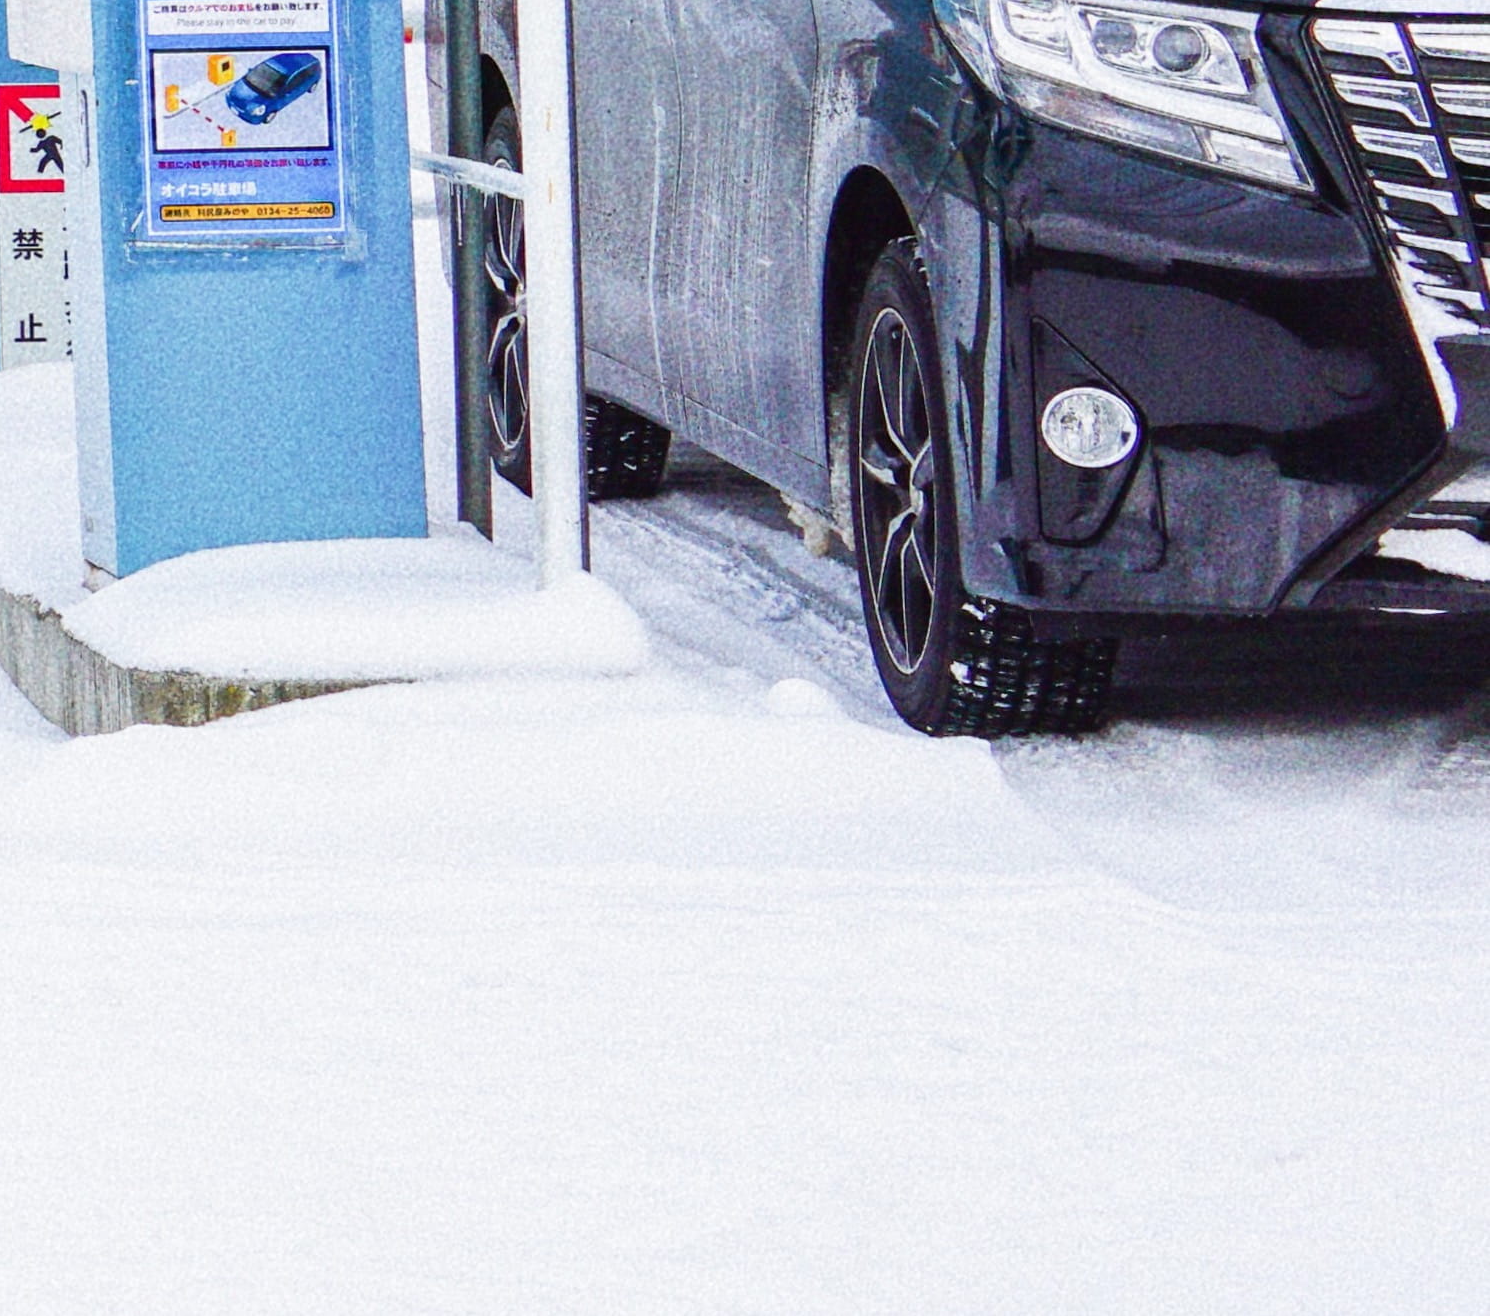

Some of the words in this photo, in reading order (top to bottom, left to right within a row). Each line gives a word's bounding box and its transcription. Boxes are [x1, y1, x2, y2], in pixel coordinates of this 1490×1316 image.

[177, 18, 204, 27] Please
[206, 18, 224, 28] stay
[226, 17, 235, 26] in
[236, 17, 251, 26] the
[253, 18, 266, 26] car
[268, 17, 278, 25] to
[280, 17, 296, 27] pay
[160, 181, 257, 197] オイコラ駐車場
[12, 228, 47, 343] 禁止
